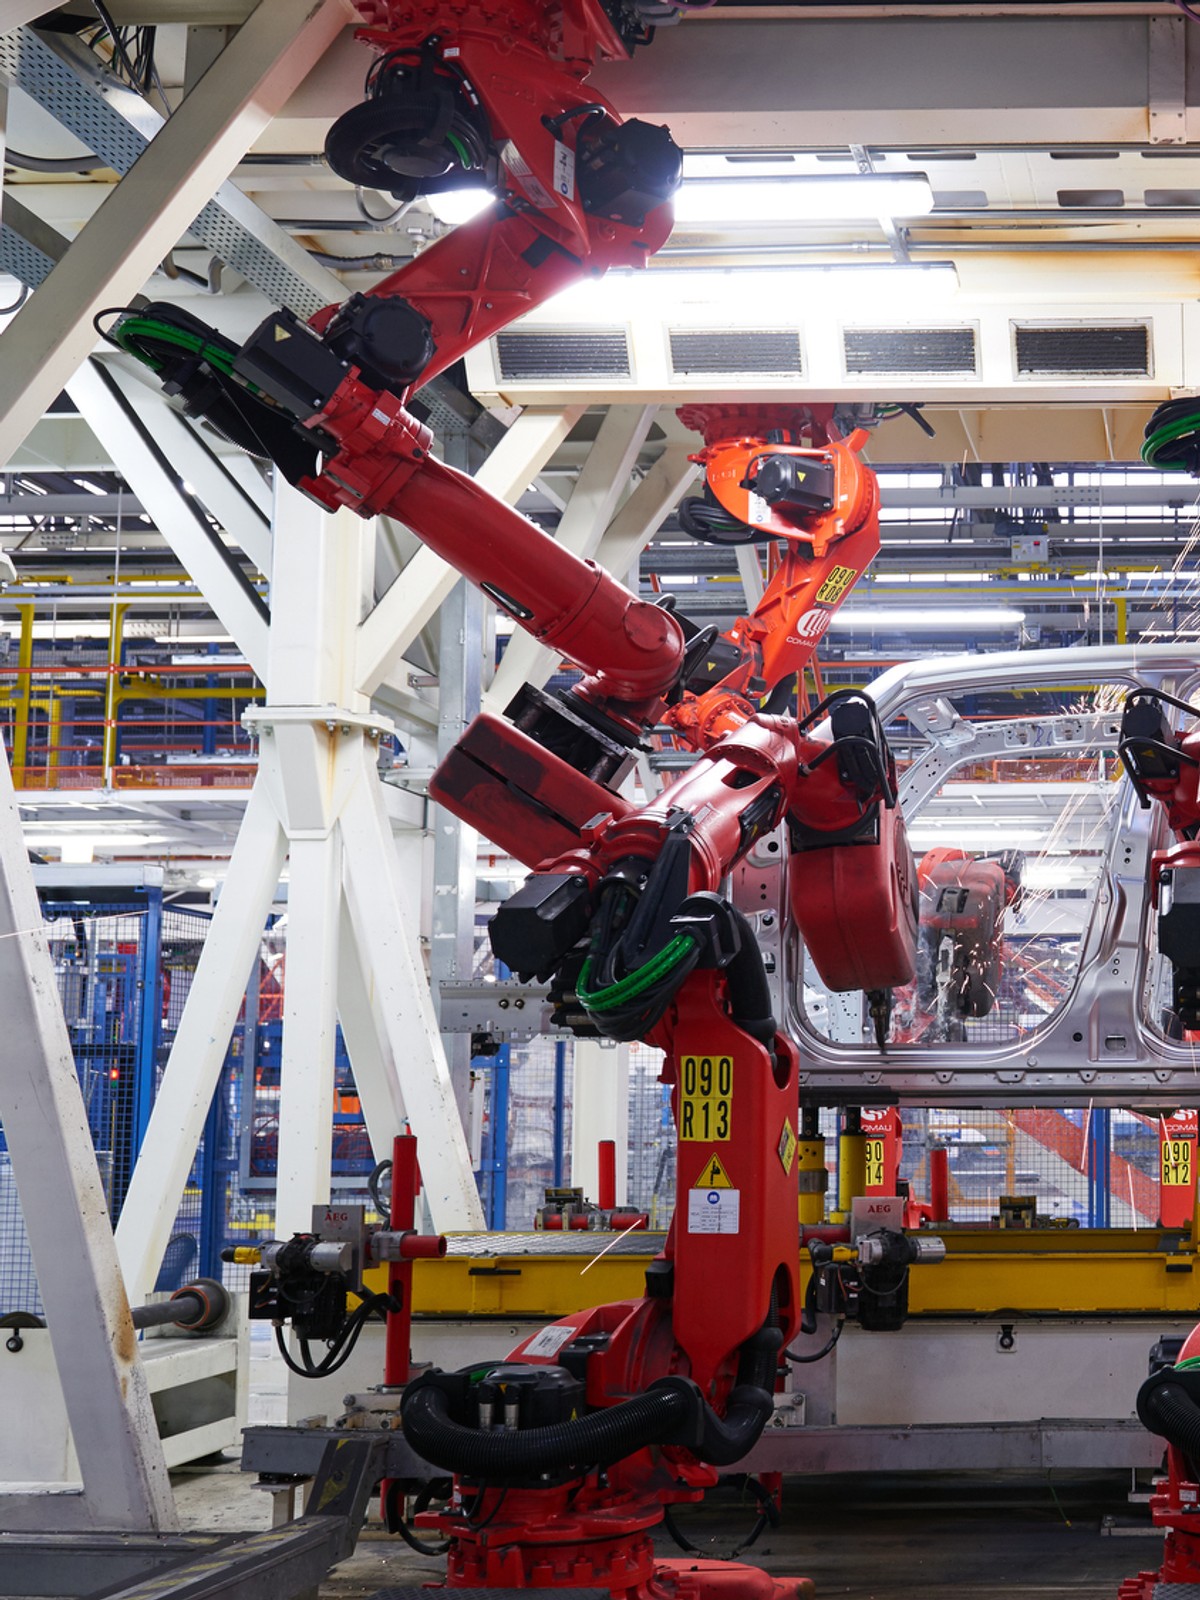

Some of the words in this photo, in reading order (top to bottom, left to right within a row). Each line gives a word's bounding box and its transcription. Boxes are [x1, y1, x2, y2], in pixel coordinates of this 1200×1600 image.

[827, 566, 856, 586] 090
[818, 583, 843, 603] R08
[685, 1057, 731, 1096] 090
[683, 1100, 728, 1138] R13
[861, 1123, 892, 1132] OMAU
[865, 1141, 882, 1162] 90
[1163, 1141, 1190, 1162] 090
[865, 1164, 882, 1184] 14
[1163, 1164, 1189, 1184] R12
[324, 1212, 348, 1221] AEG
[868, 1204, 891, 1213] AEG
